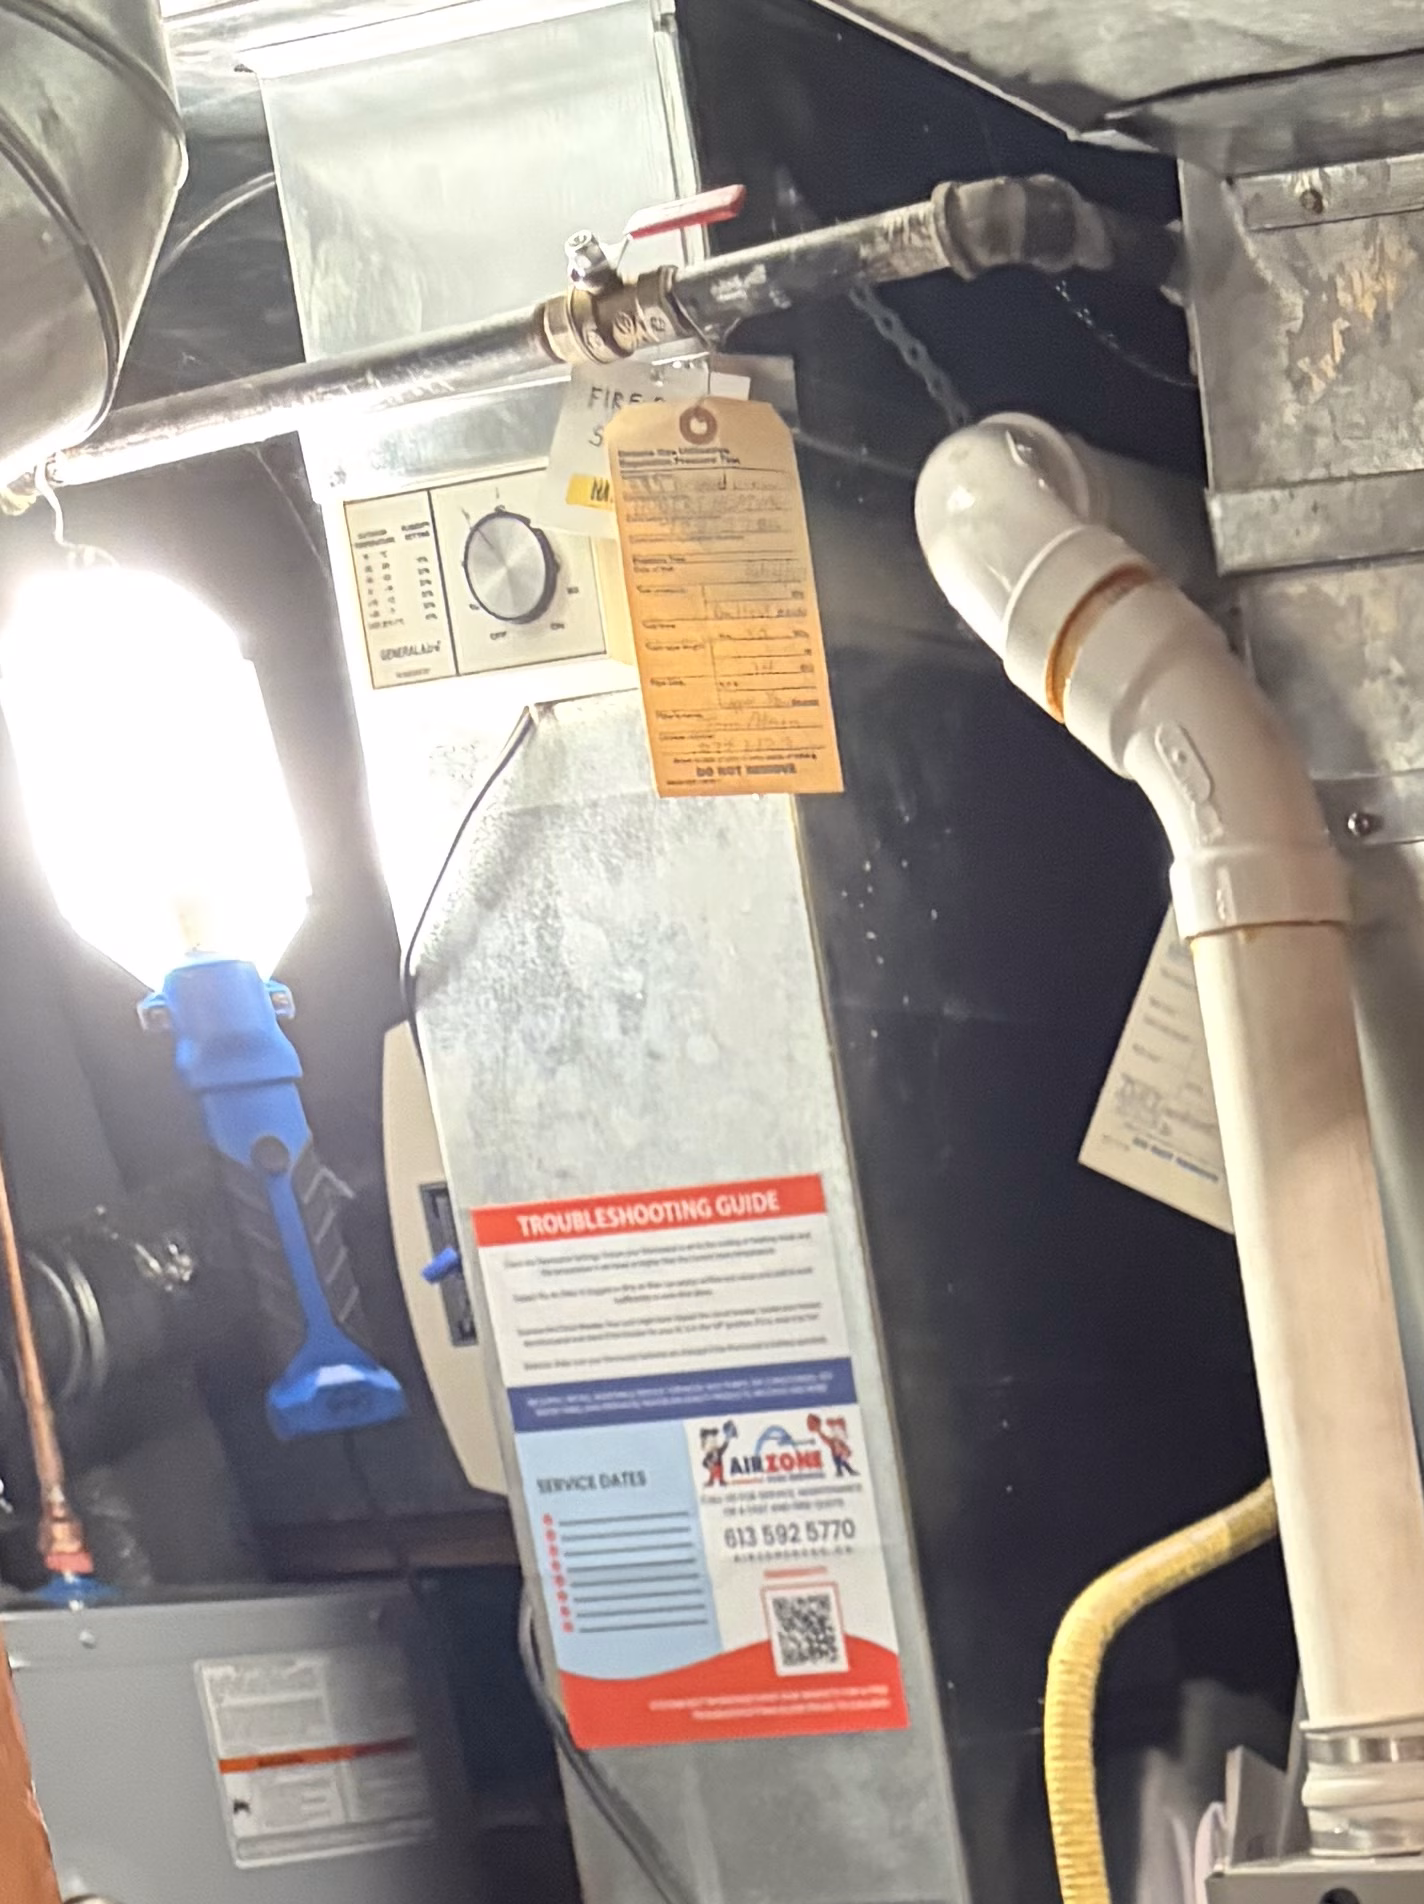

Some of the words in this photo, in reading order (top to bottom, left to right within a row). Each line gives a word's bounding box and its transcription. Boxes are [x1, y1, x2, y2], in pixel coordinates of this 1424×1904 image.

[516, 1196, 713, 1238] TROUBLESHOOTING
[715, 1189, 781, 1217] GUIDE
[536, 1472, 597, 1495] SERVICE
[599, 1469, 648, 1490] DATES
[724, 1524, 757, 1549] 613
[762, 1521, 801, 1546] 592
[805, 1518, 856, 1543] 5770
